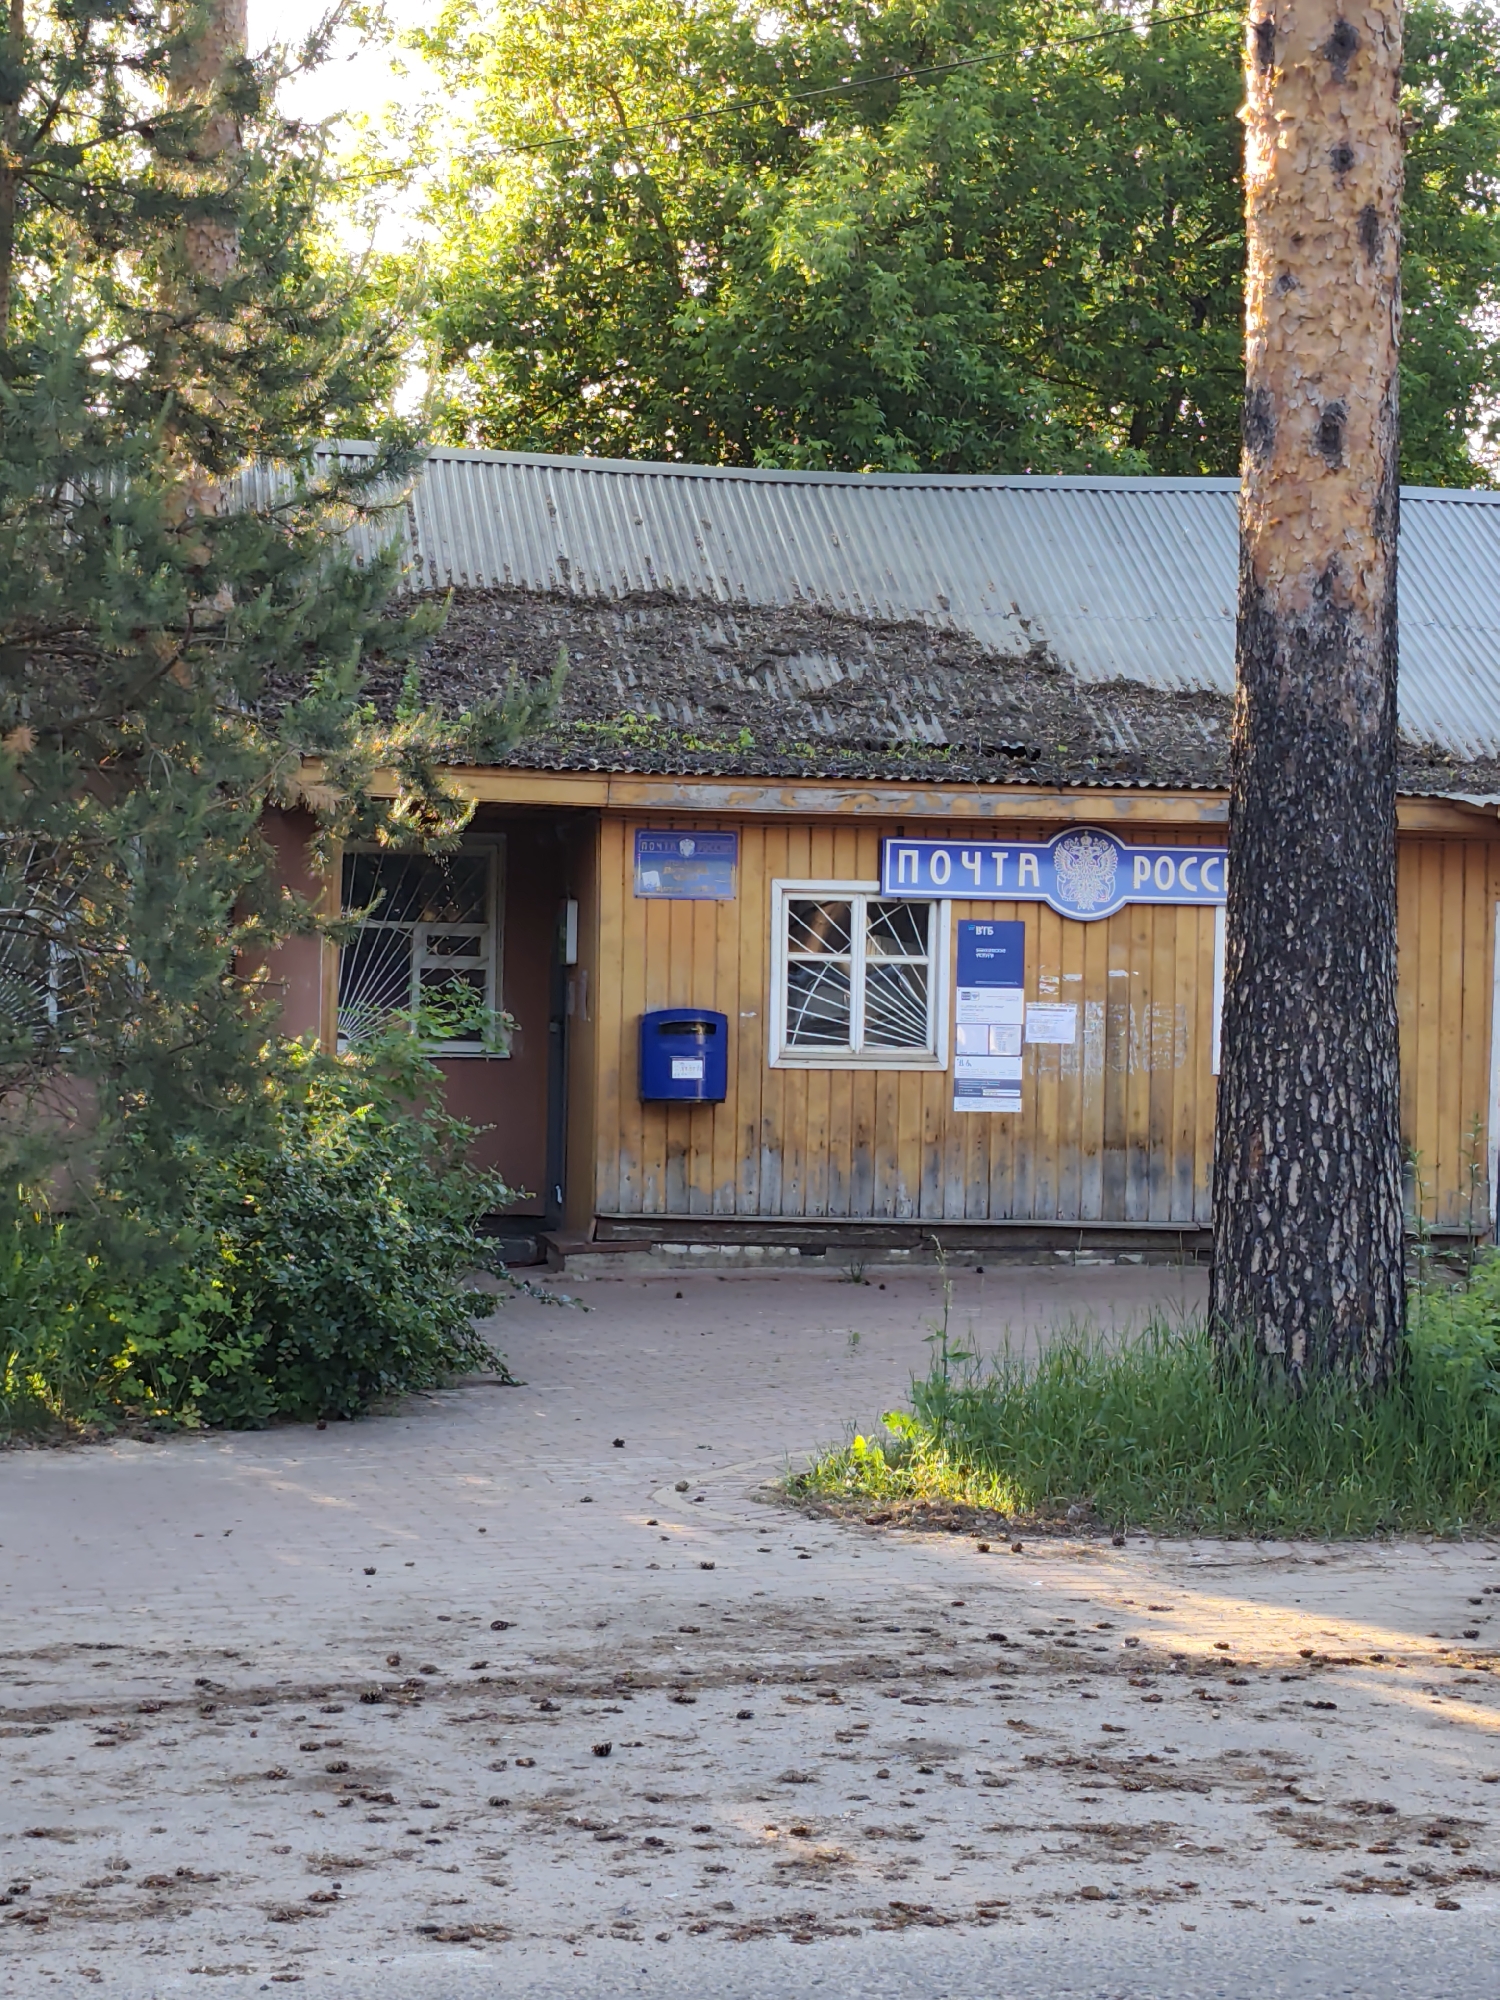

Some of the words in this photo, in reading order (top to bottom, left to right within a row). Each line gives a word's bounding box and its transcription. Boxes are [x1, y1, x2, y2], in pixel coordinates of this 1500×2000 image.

[641, 841, 677, 851] ПОЧТА
[898, 849, 1040, 887] ПОЧТА
[1133, 855, 1229, 892] РОСС
[975, 925, 995, 936] ВТБ
